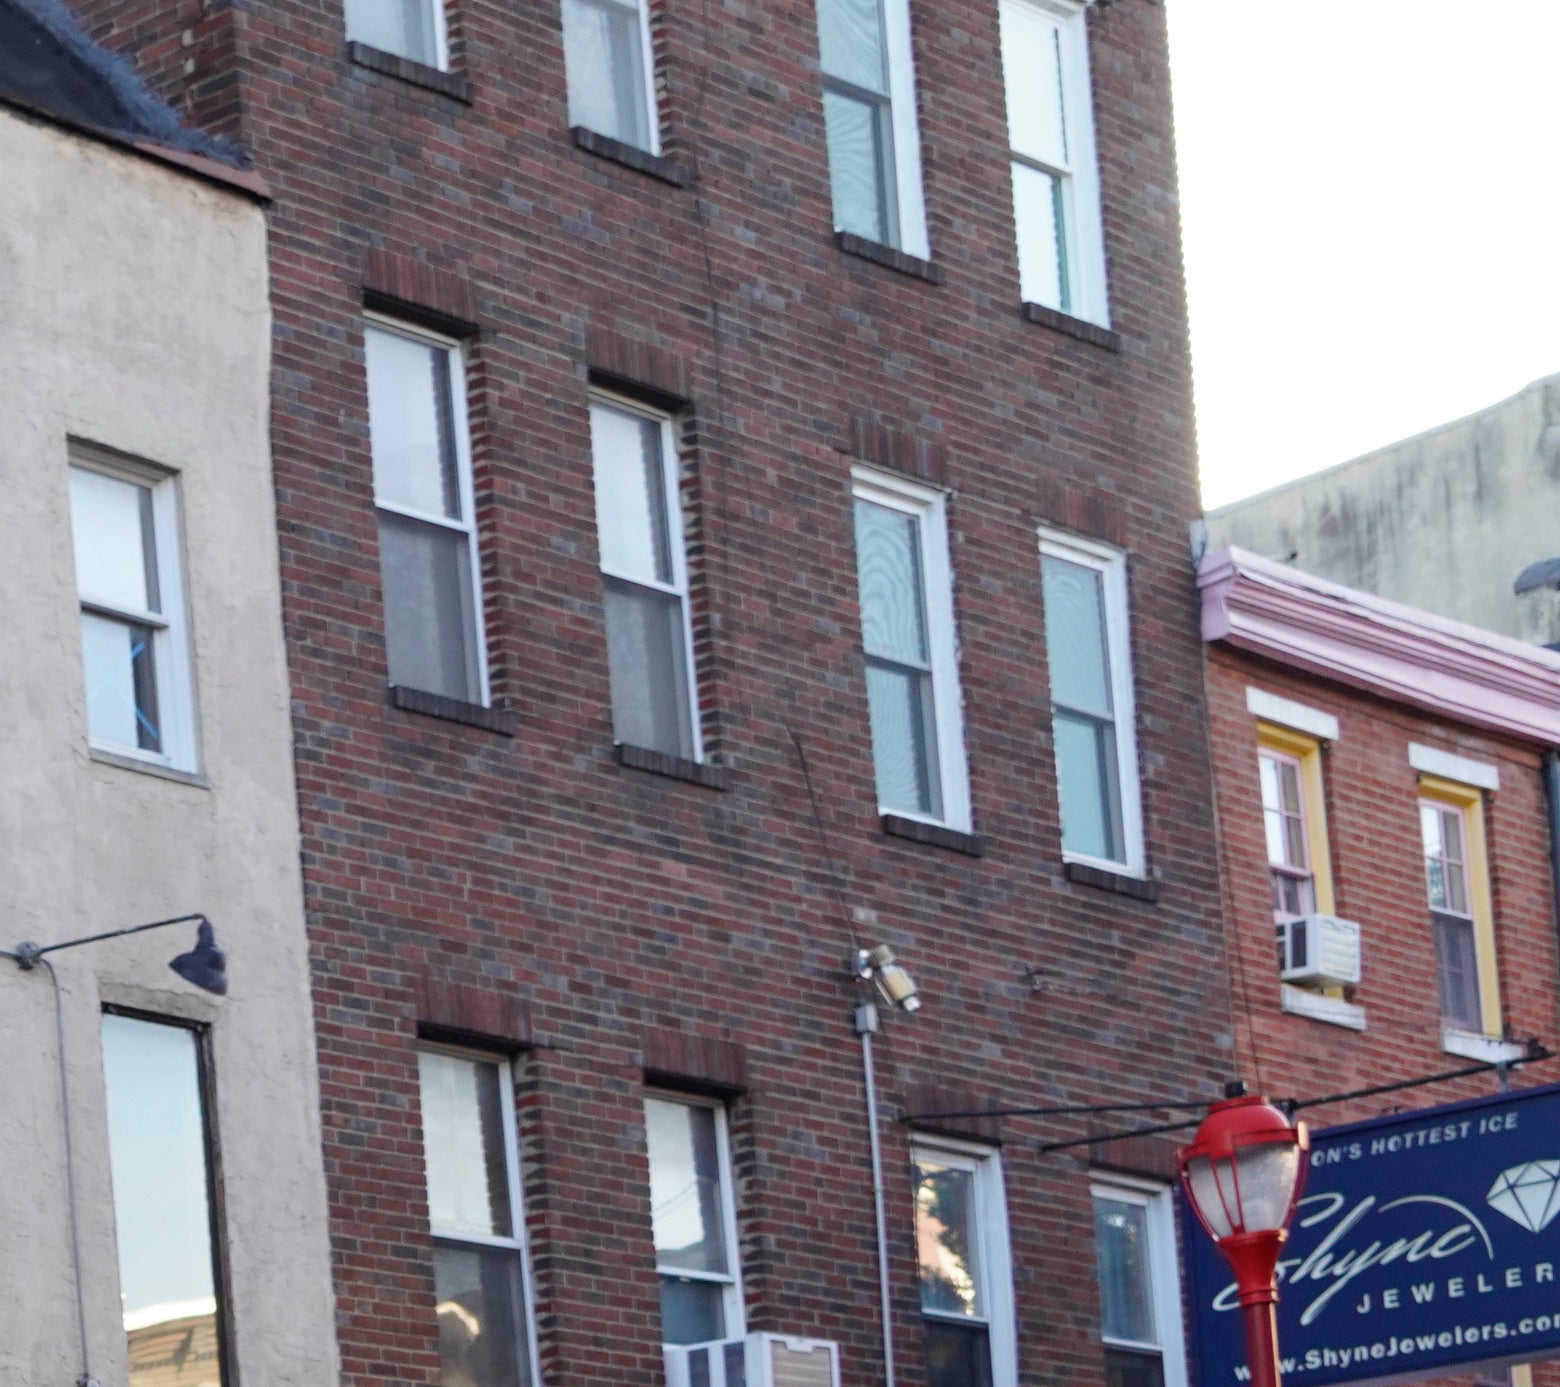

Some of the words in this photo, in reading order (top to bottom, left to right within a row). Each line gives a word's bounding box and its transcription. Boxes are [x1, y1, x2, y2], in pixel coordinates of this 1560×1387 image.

[1310, 1143, 1362, 1168] ON'S
[1371, 1121, 1471, 1155] HOTTEST
[1478, 1111, 1520, 1135] ICE
[1356, 1262, 1556, 1315] JEWELER
